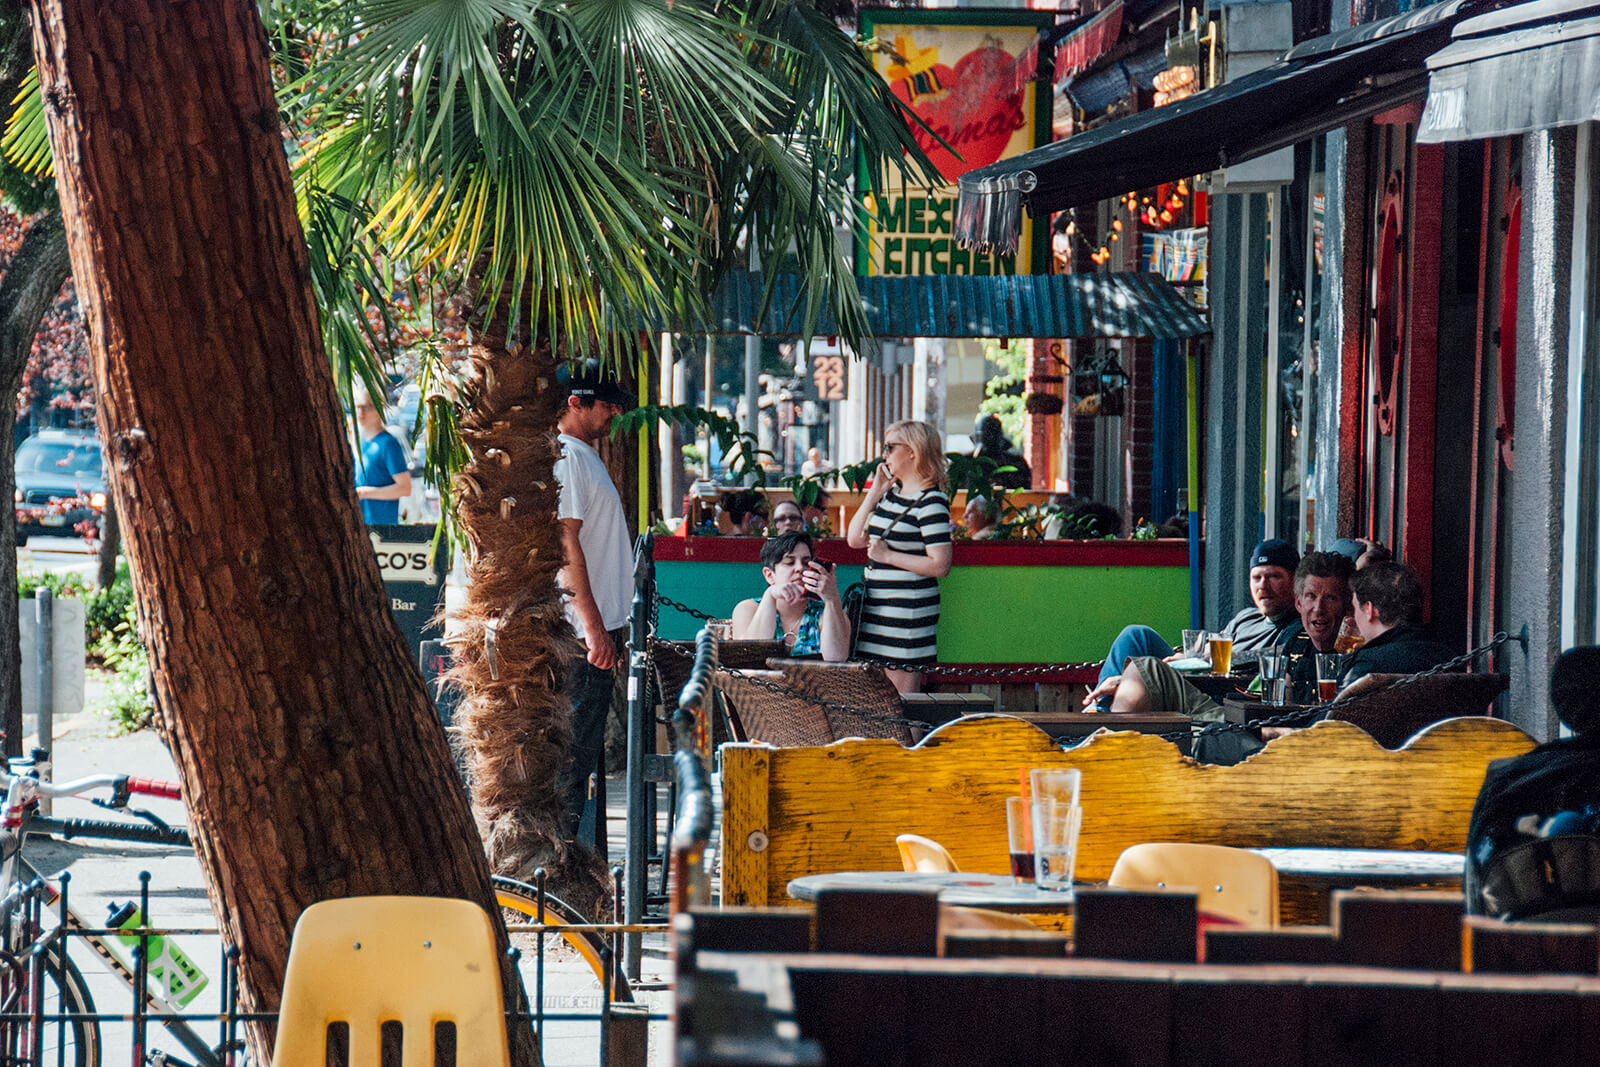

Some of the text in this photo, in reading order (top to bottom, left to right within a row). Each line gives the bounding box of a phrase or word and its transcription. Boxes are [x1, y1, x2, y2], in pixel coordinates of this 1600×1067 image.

[878, 197, 959, 233] MEXI
[884, 238, 1016, 274] KITCHEN
[813, 356, 844, 378] 23
[814, 377, 844, 400] 12
[375, 552, 427, 570] CO'S
[391, 598, 417, 611] Bar
